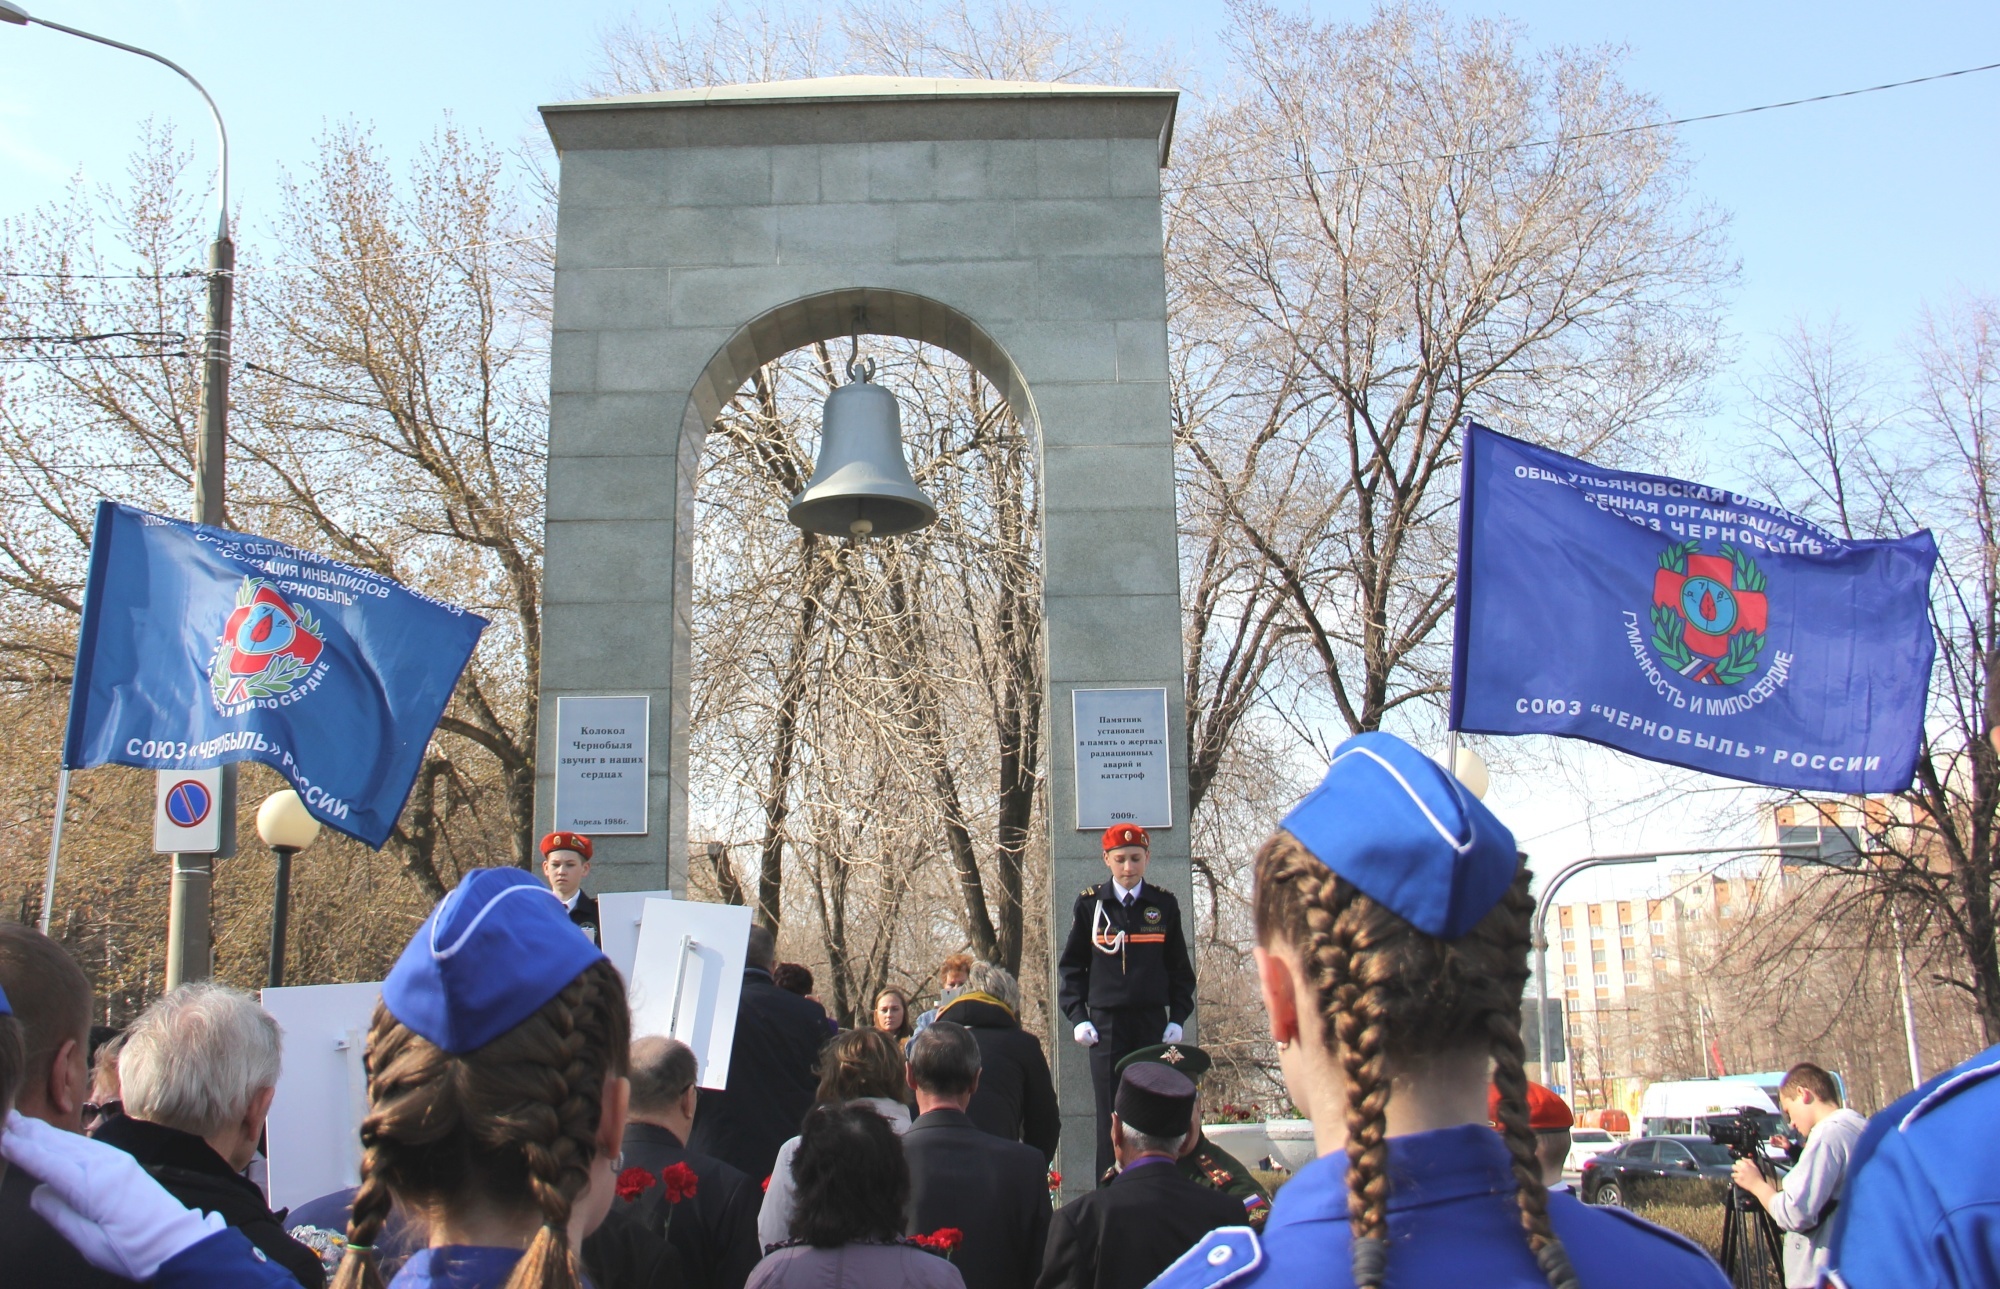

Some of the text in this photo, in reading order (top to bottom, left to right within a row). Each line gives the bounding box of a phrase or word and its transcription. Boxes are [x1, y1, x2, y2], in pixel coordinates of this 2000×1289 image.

[1567, 472, 1852, 550] УЛЬЯНОВСКАЯ ОБЛАСТНА
[1665, 503, 1797, 543] ОРГАНИЗАЦИЯ
[244, 542, 329, 565] ОБЛАСТНАЯ
[302, 566, 391, 599] ИНВАЛИДОВ
[276, 579, 359, 607] ЕРНОБЫЛЬ”
[1622, 610, 1793, 716] ГУМАННОСТЬ И МИЛОСЕРДИЕ
[235, 660, 331, 716] МИЛОСЕРДИЕ
[1099, 716, 1142, 724] Памятник
[581, 726, 625, 735] Колокол
[1097, 728, 1145, 736] установлен
[1515, 698, 1880, 771] СОЮЗ “ЧЕРНОБЫЛЬ” РОССИИ
[573, 741, 632, 751] Чернобыля
[1128, 739, 1163, 747] жертвах
[1090, 749, 1153, 758] радиационных
[561, 757, 596, 767] звучит
[1103, 759, 1133, 769] аварий
[126, 737, 187, 759] СОЮЗ
[282, 751, 350, 820] РОССИИ
[581, 771, 623, 780] сердцах
[1101, 771, 1145, 780] катастроф
[1110, 812, 1138, 820] 2009г.
[573, 818, 602, 827] Апрель
